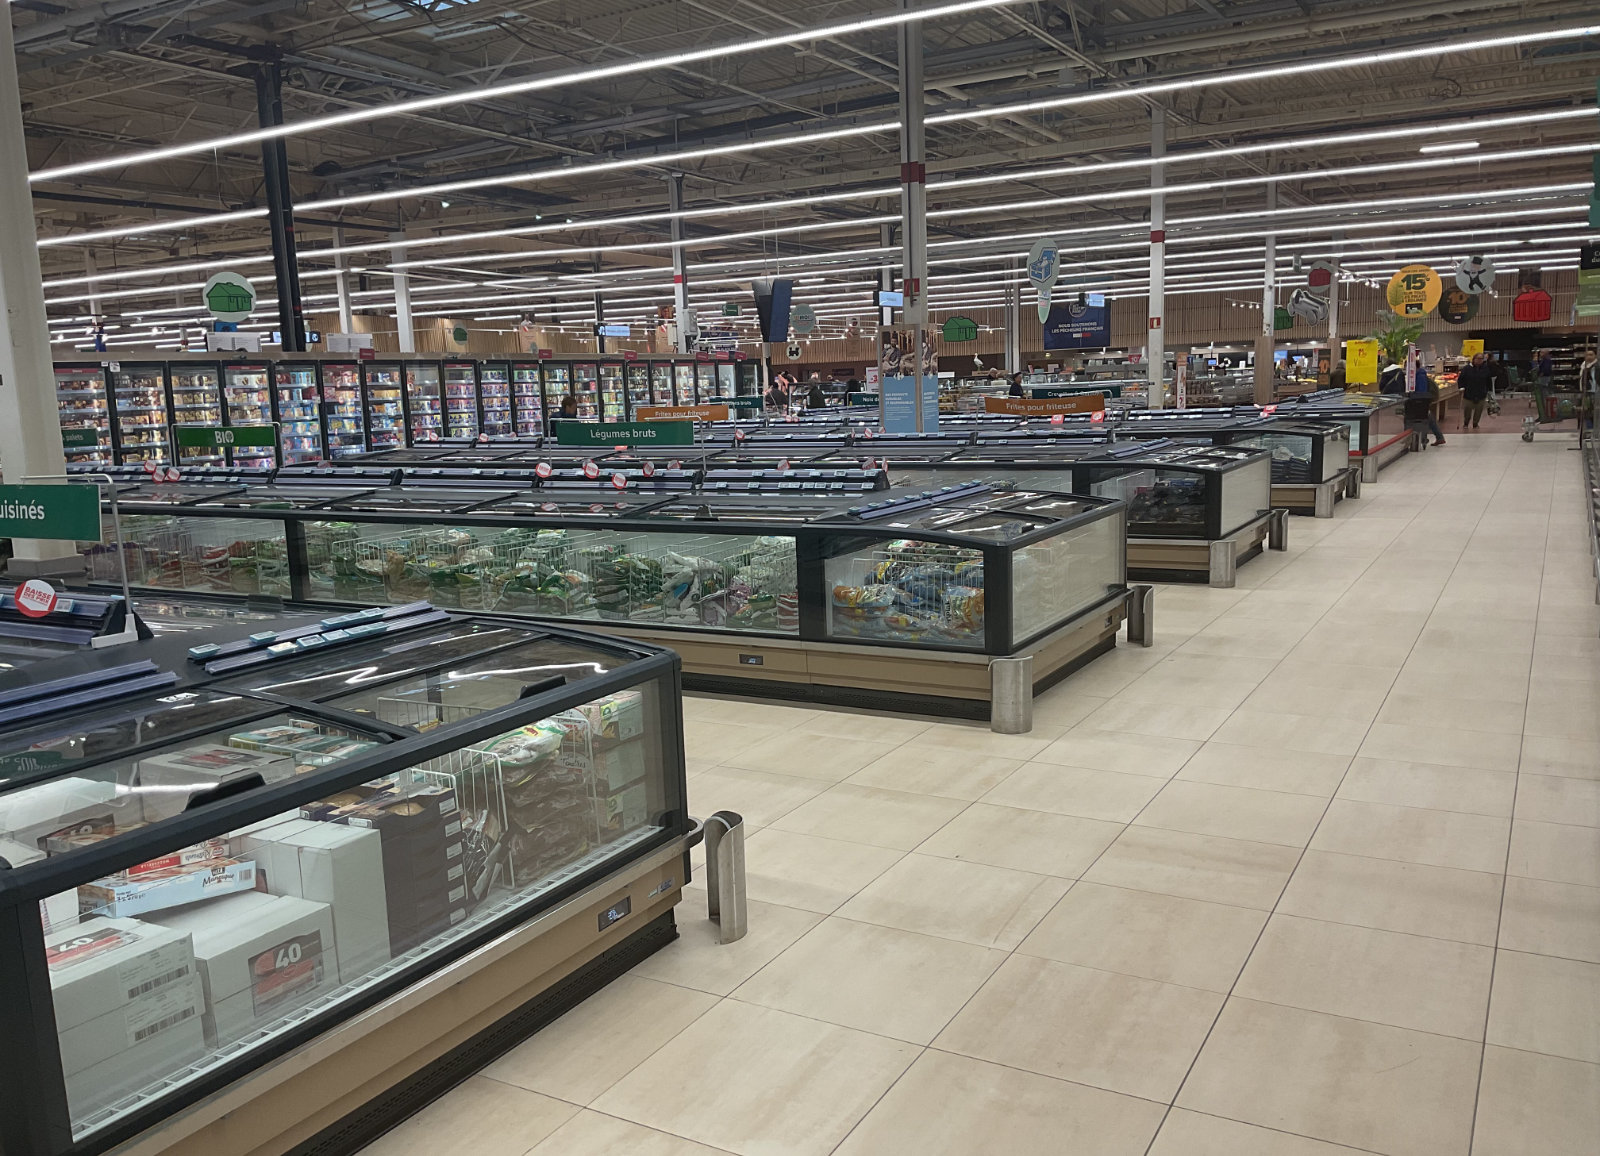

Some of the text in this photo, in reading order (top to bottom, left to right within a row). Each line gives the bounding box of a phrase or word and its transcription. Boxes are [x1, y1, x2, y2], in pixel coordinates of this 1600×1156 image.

[1006, 402, 1077, 412] Frites pour friteuse
[214, 430, 234, 444] BIO
[590, 428, 656, 441] Légumes bruts
[24, 586, 52, 600] BAISSE
[275, 943, 302, 969] 40
